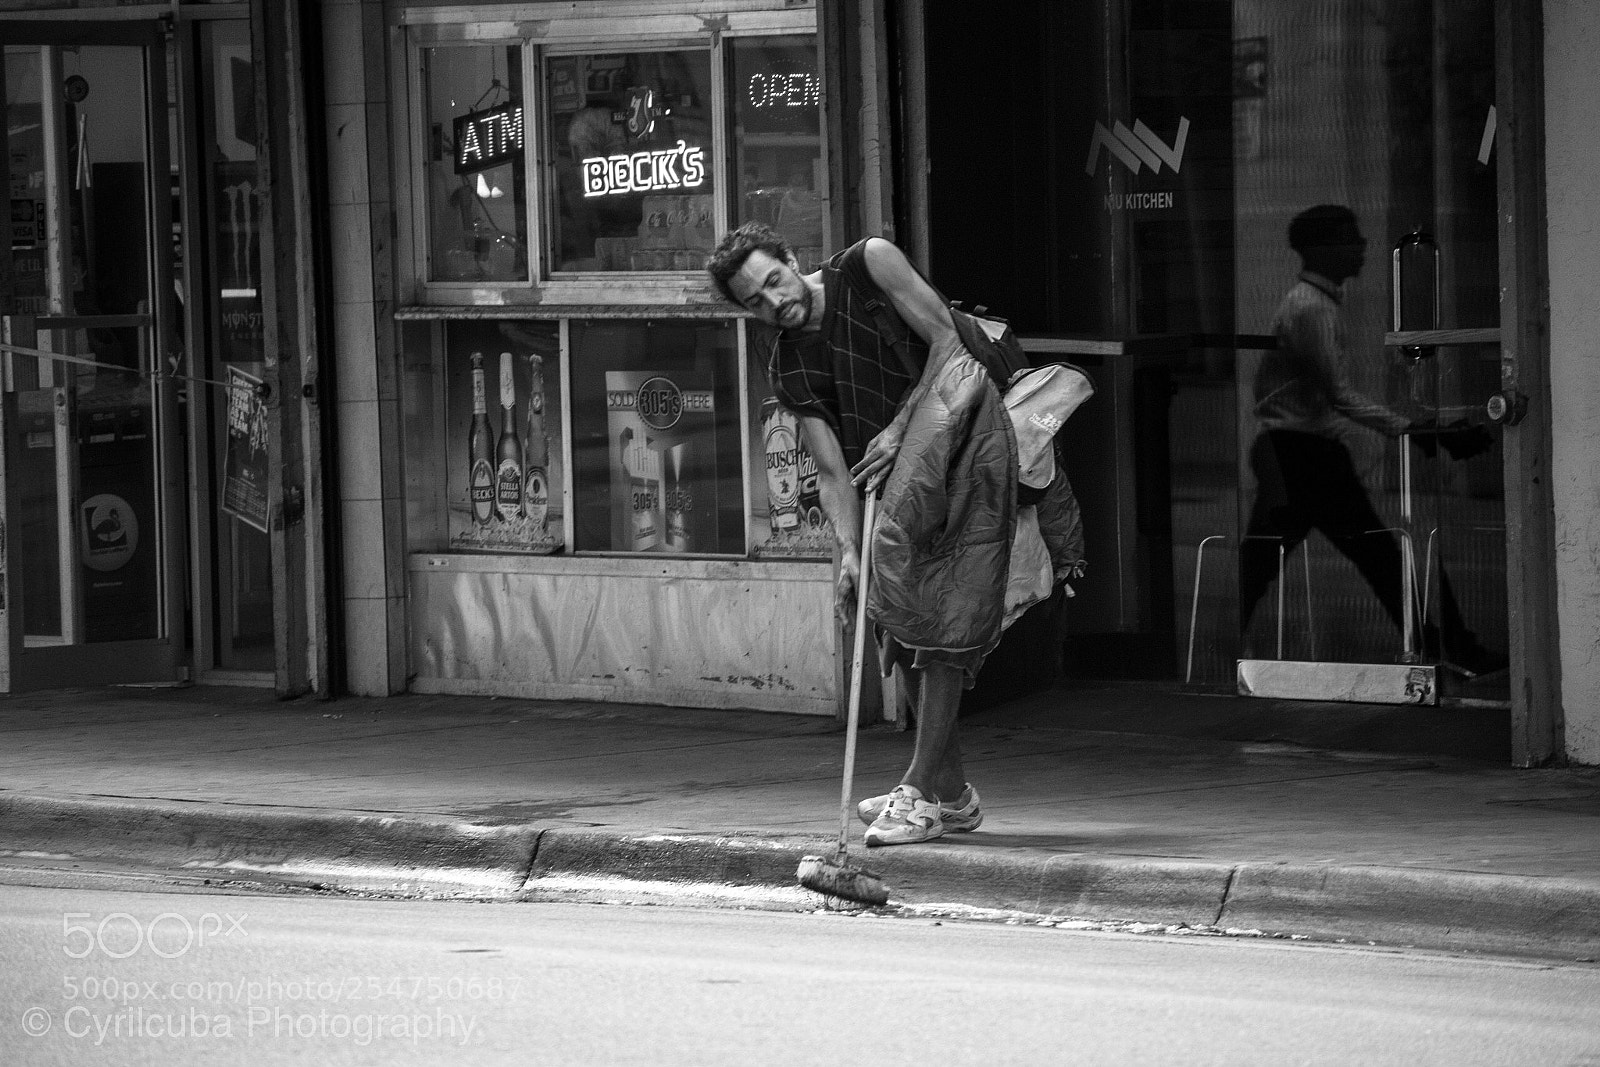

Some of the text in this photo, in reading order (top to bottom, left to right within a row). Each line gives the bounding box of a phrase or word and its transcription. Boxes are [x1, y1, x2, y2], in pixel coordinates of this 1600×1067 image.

[749, 73, 820, 108] OPEN
[461, 107, 523, 165] ATM
[582, 139, 704, 198] BECK'S
[1125, 192, 1173, 210] KITCHEN
[222, 309, 264, 330] MONST
[609, 389, 710, 416] SOLD 305's HERE
[766, 448, 798, 469] BUSCH
